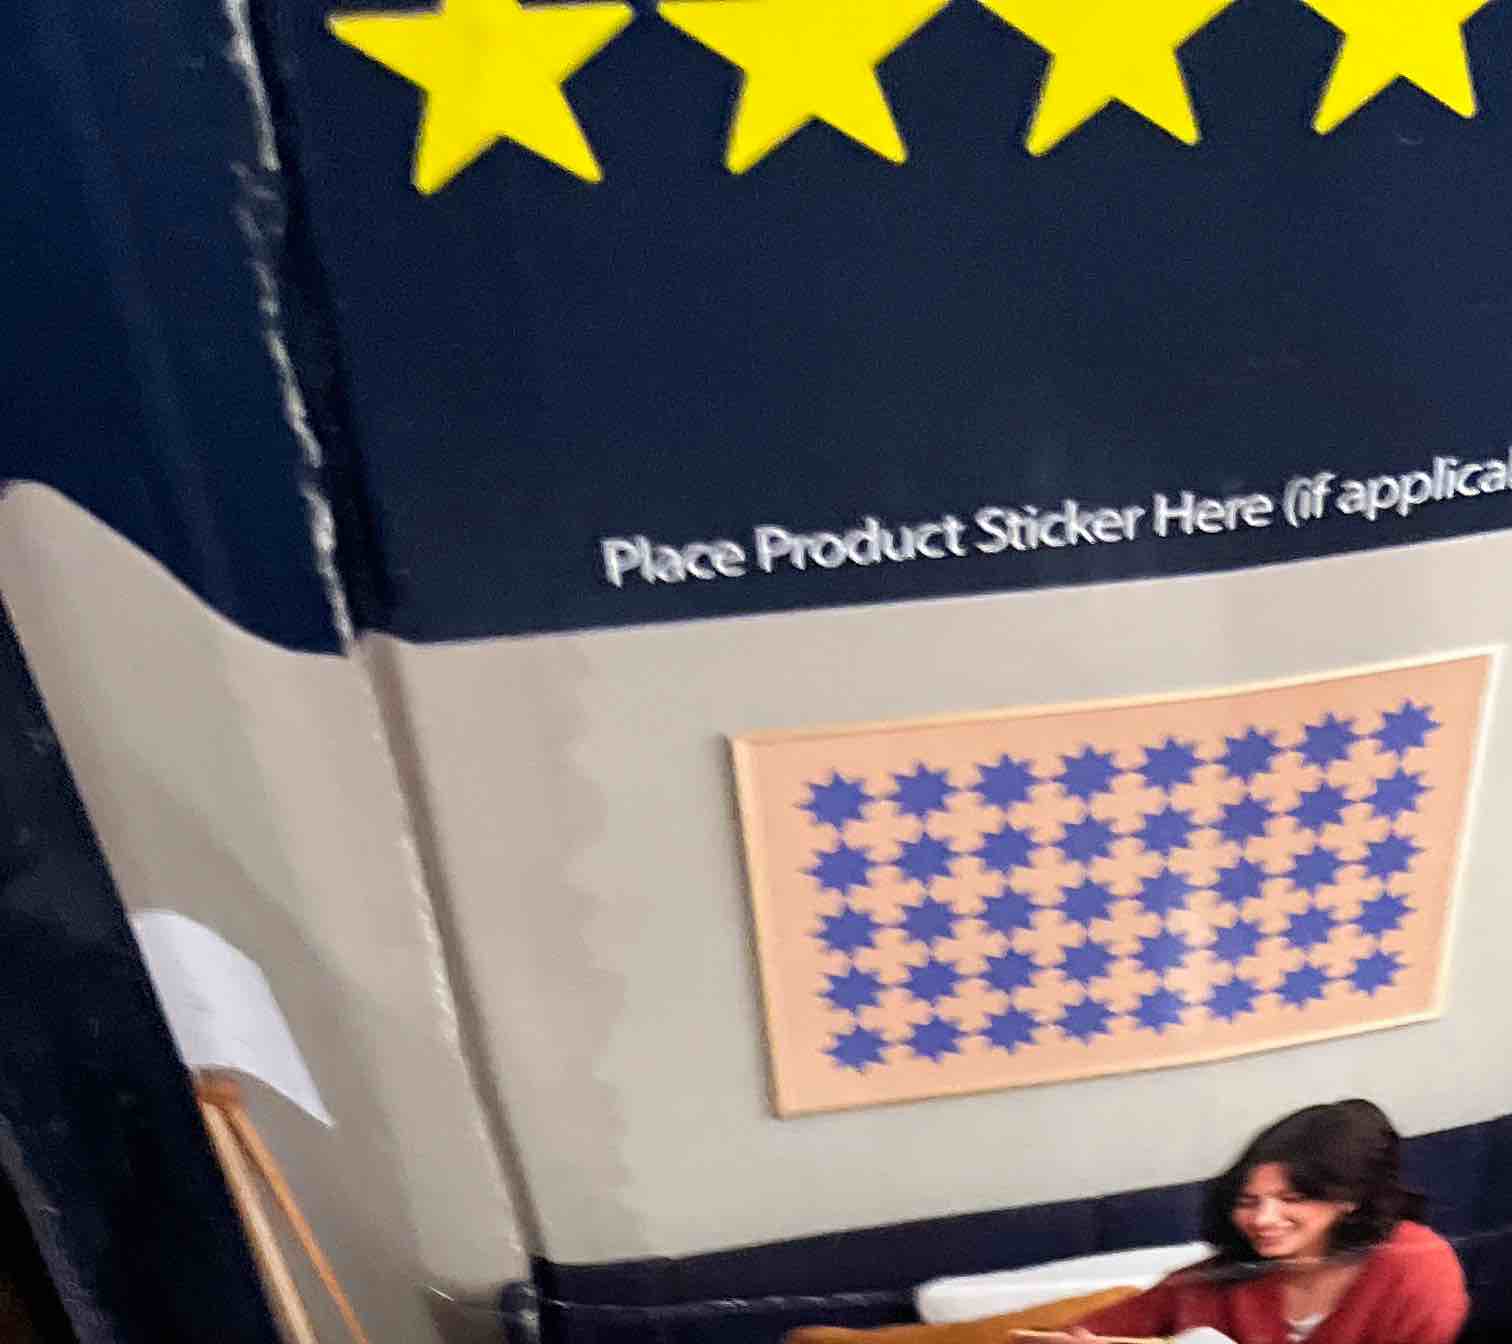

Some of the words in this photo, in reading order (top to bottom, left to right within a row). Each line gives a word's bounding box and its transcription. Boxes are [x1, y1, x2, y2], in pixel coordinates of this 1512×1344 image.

[601, 535, 746, 588] Place
[754, 515, 967, 573] Product
[973, 500, 1144, 555] Sticker
[1153, 490, 1273, 537] Here
[1283, 471, 1336, 528] (if
